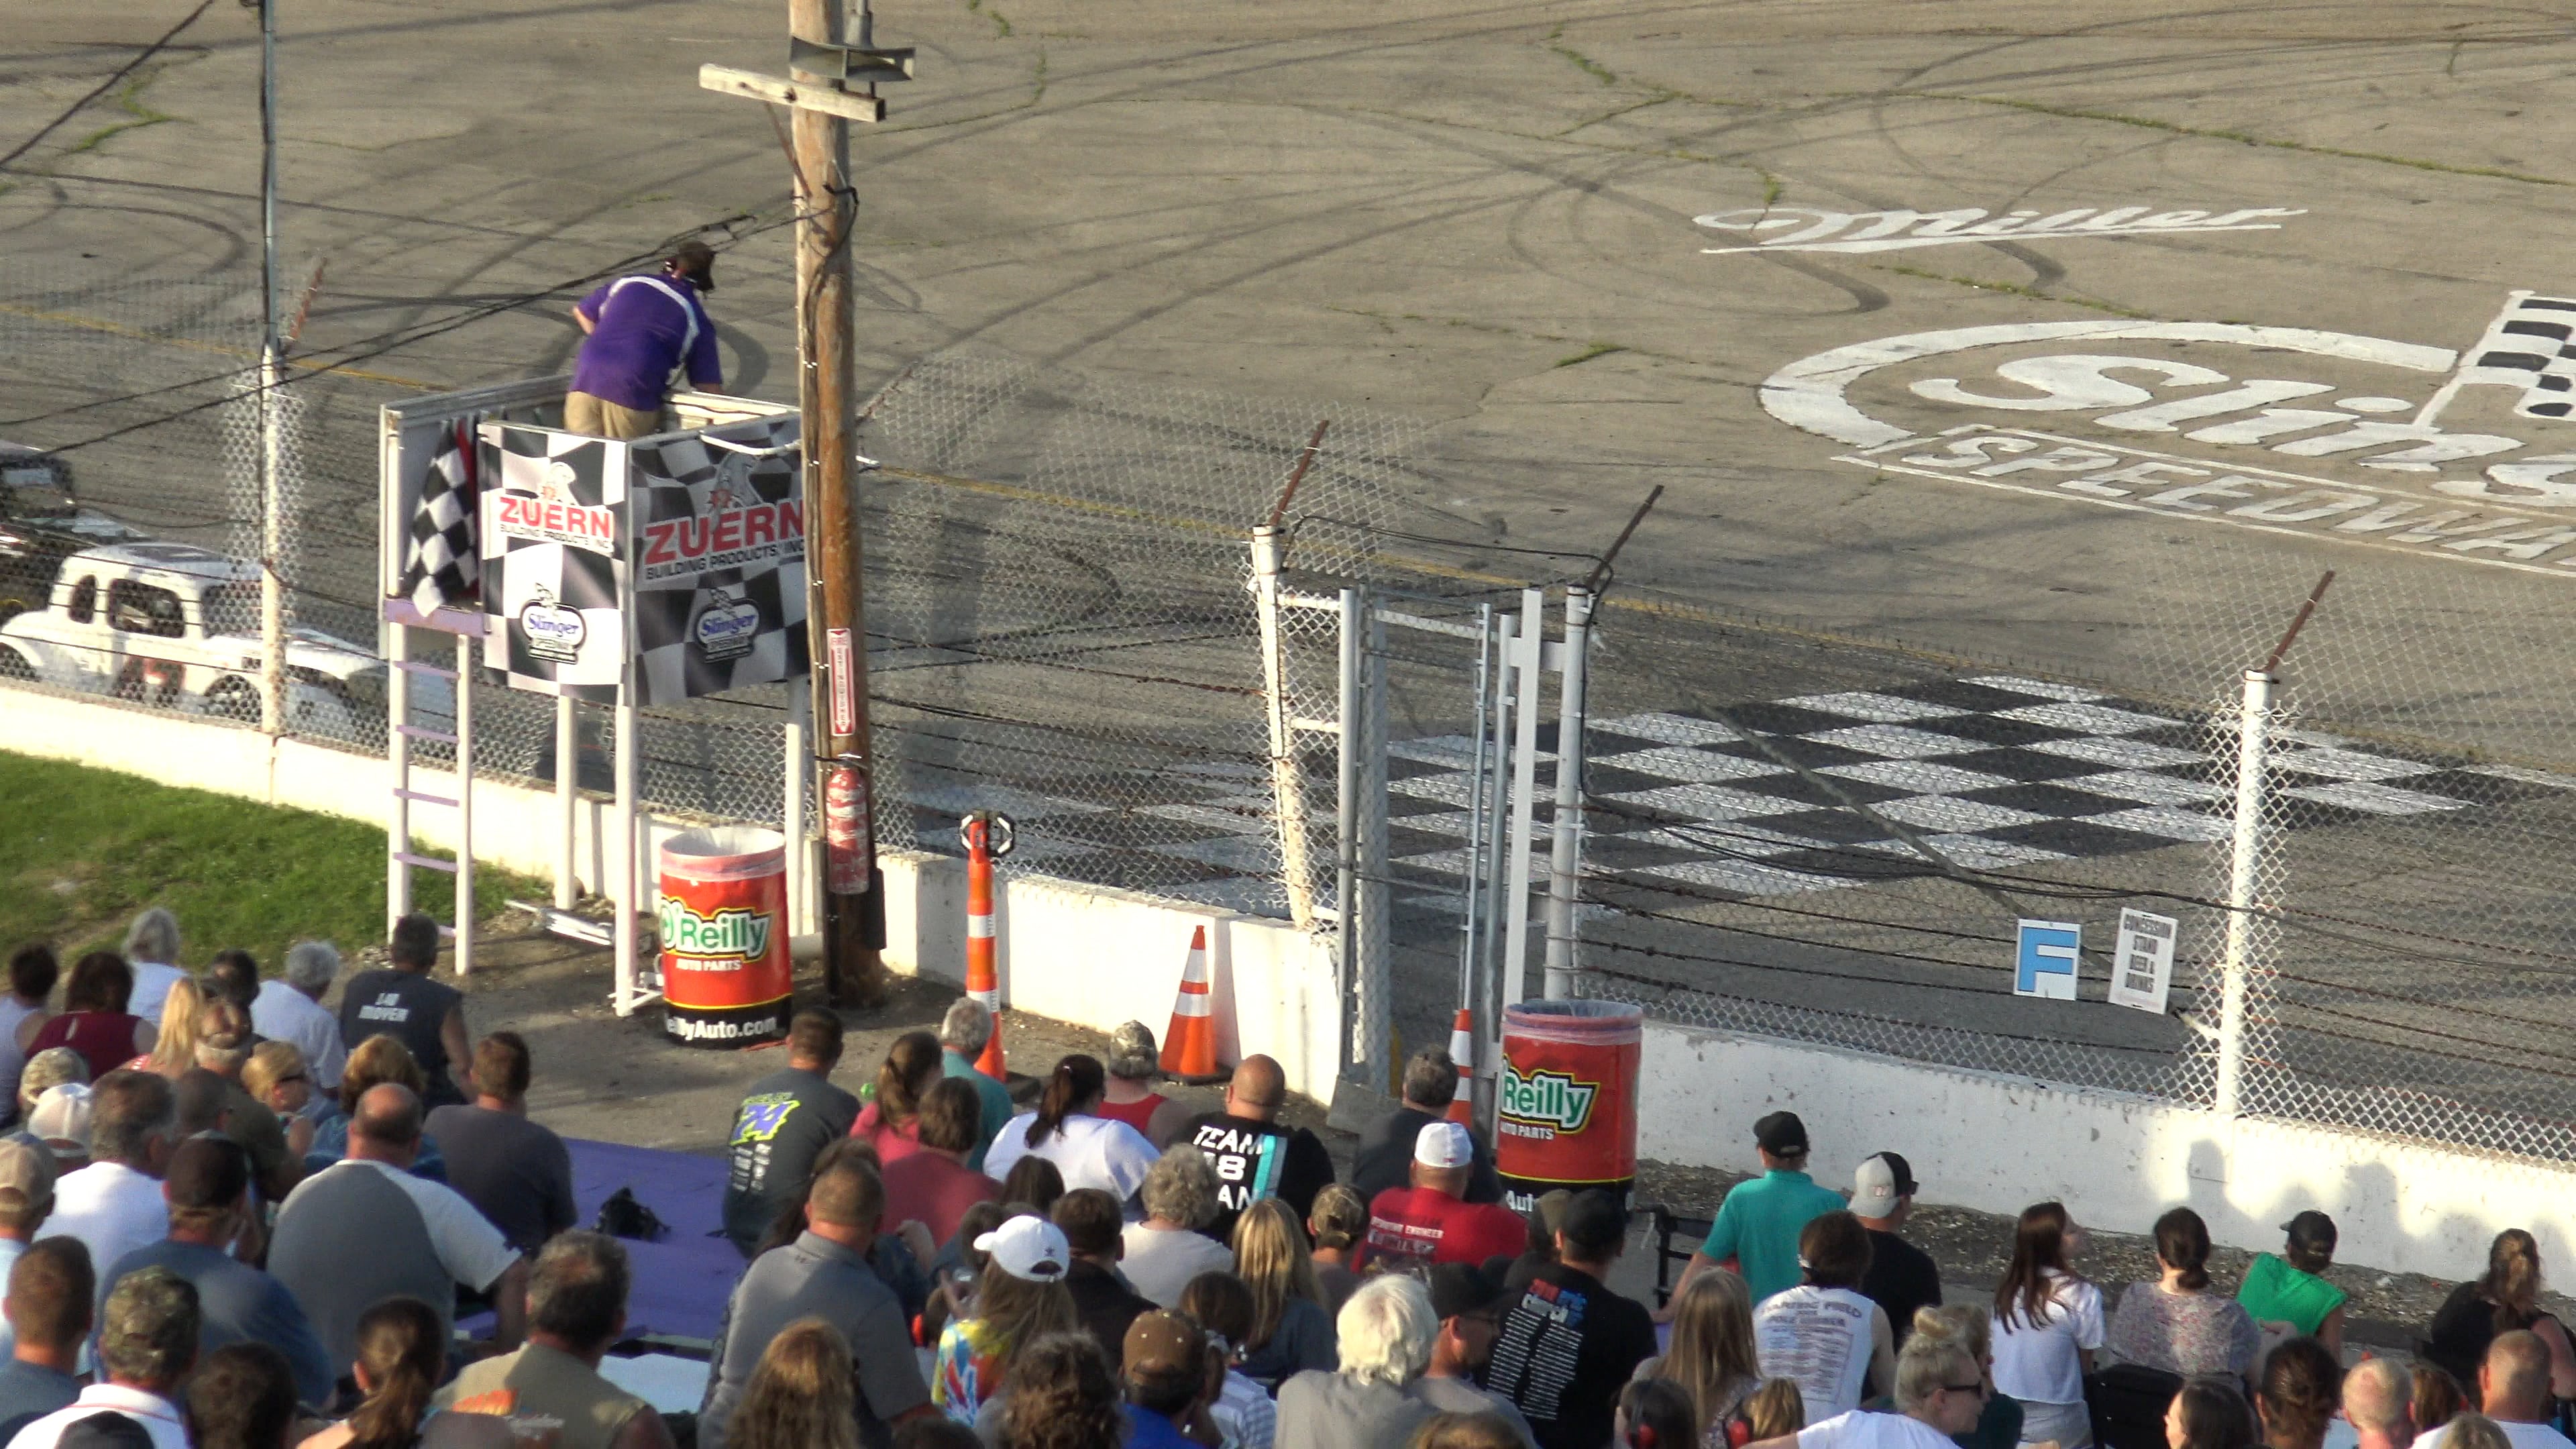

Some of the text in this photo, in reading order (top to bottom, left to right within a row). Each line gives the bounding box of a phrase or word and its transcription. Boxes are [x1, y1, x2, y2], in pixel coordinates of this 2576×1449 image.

[1693, 207, 2308, 254] Miller
[1900, 436, 2576, 566] SPEEDWA
[499, 496, 610, 538] ZUERN
[645, 498, 804, 566] ZUERN
[645, 557, 707, 580] BUILDING
[528, 613, 580, 637] Slinger
[700, 614, 756, 637] Slinger
[676, 958, 742, 971] AUTO PARTS
[2017, 926, 2078, 992] F
[665, 1016, 777, 1040] eillyAuto.com
[1503, 1074, 1587, 1124] Reilly
[1193, 1125, 1265, 1155] TEAM
[1519, 1125, 1554, 1140] PARTS
